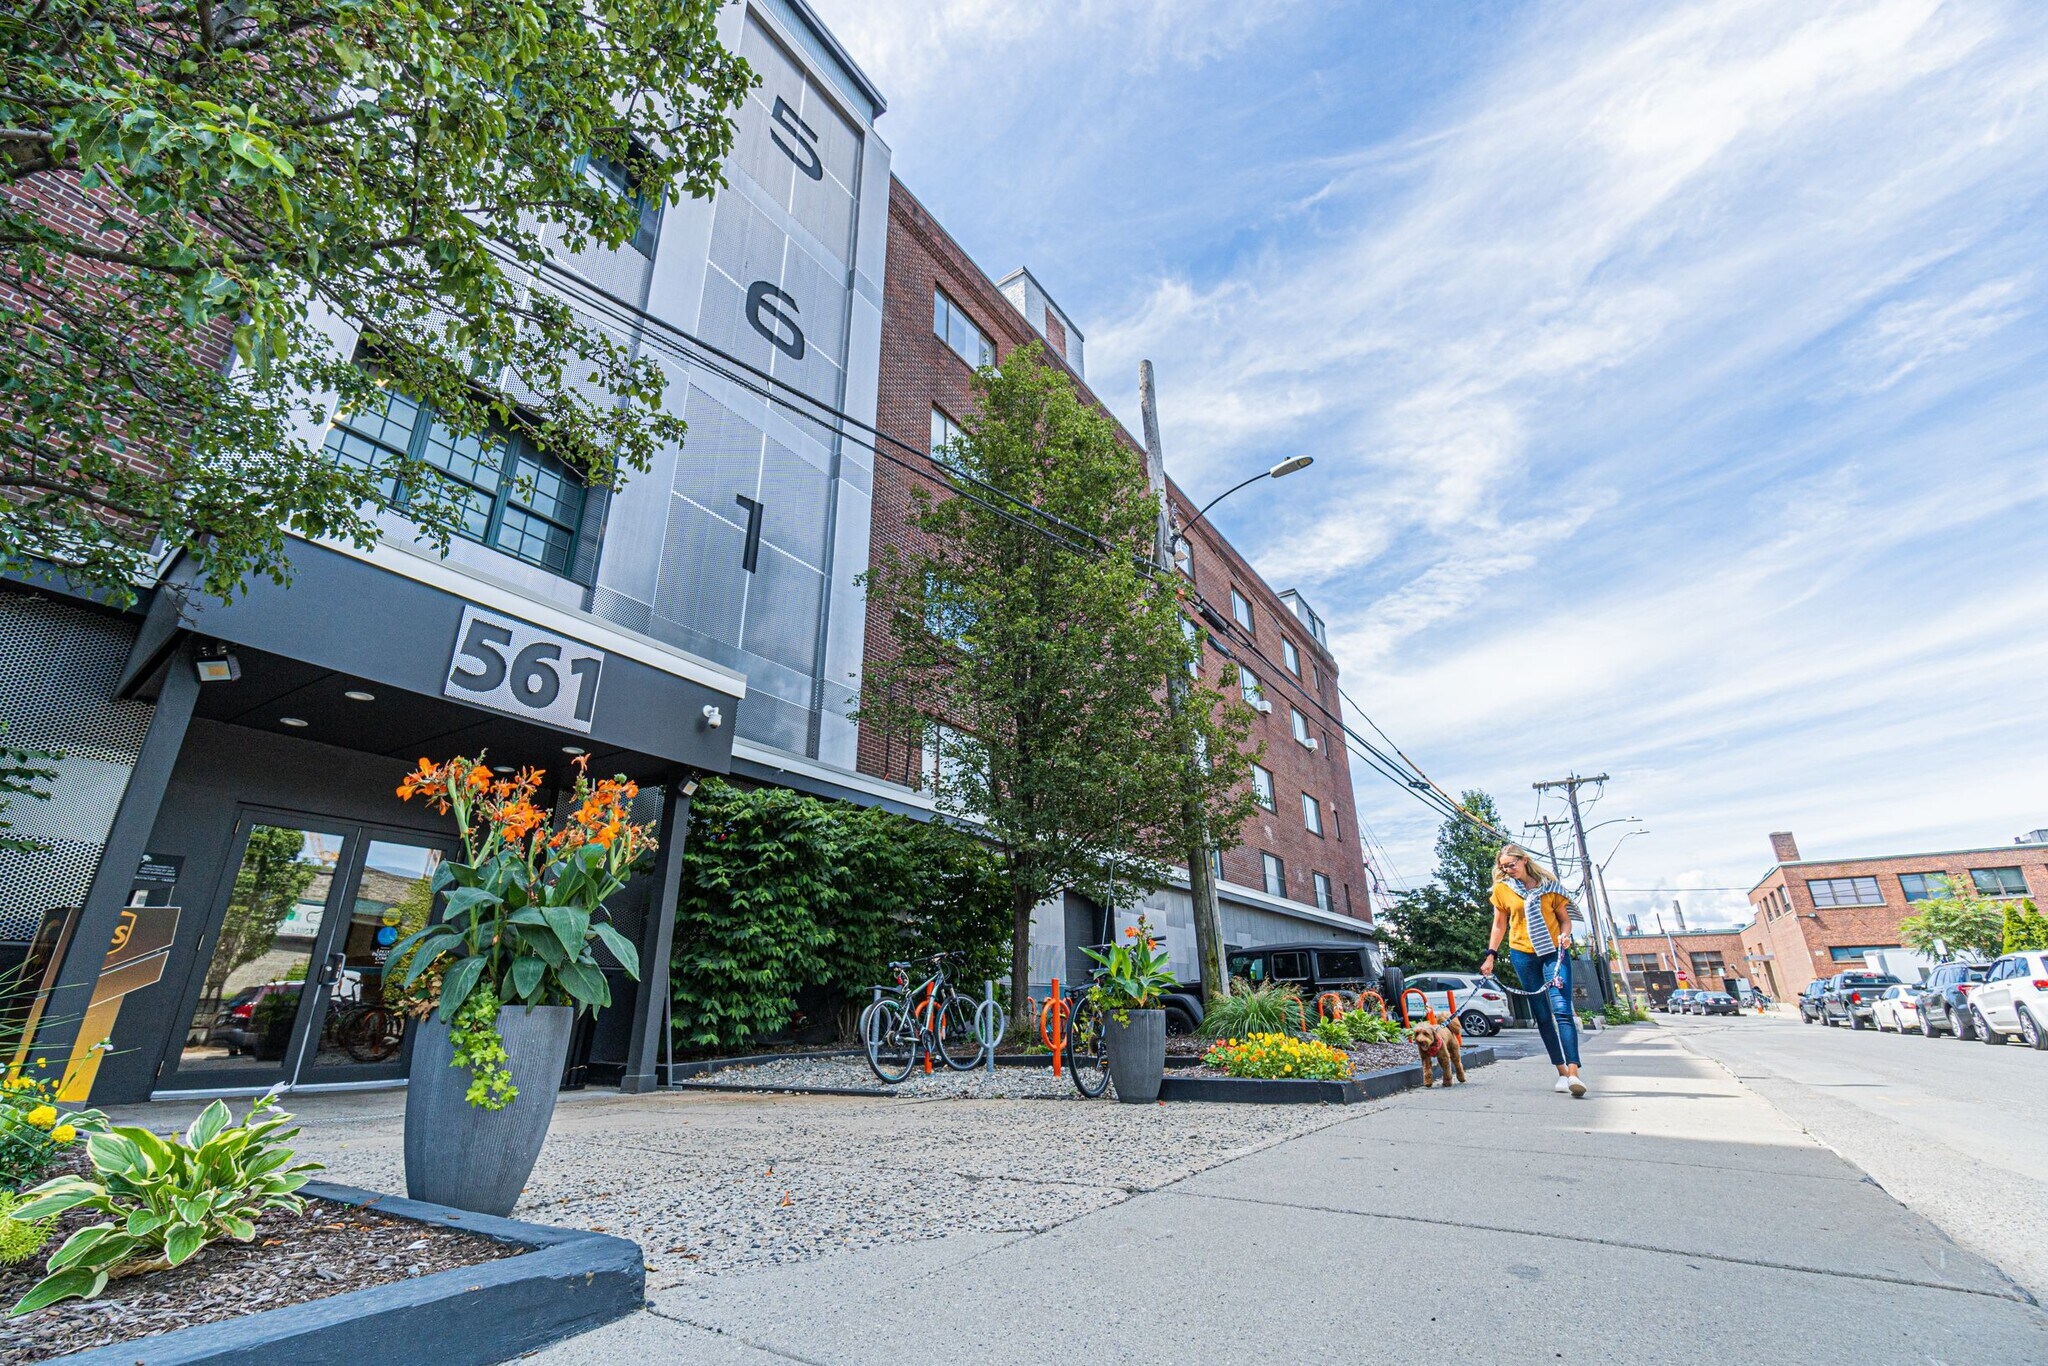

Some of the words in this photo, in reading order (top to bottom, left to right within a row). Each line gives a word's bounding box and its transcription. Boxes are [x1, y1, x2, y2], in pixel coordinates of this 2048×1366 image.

[770, 94, 824, 181] 5
[745, 279, 805, 361] 6
[450, 617, 602, 723] 561
